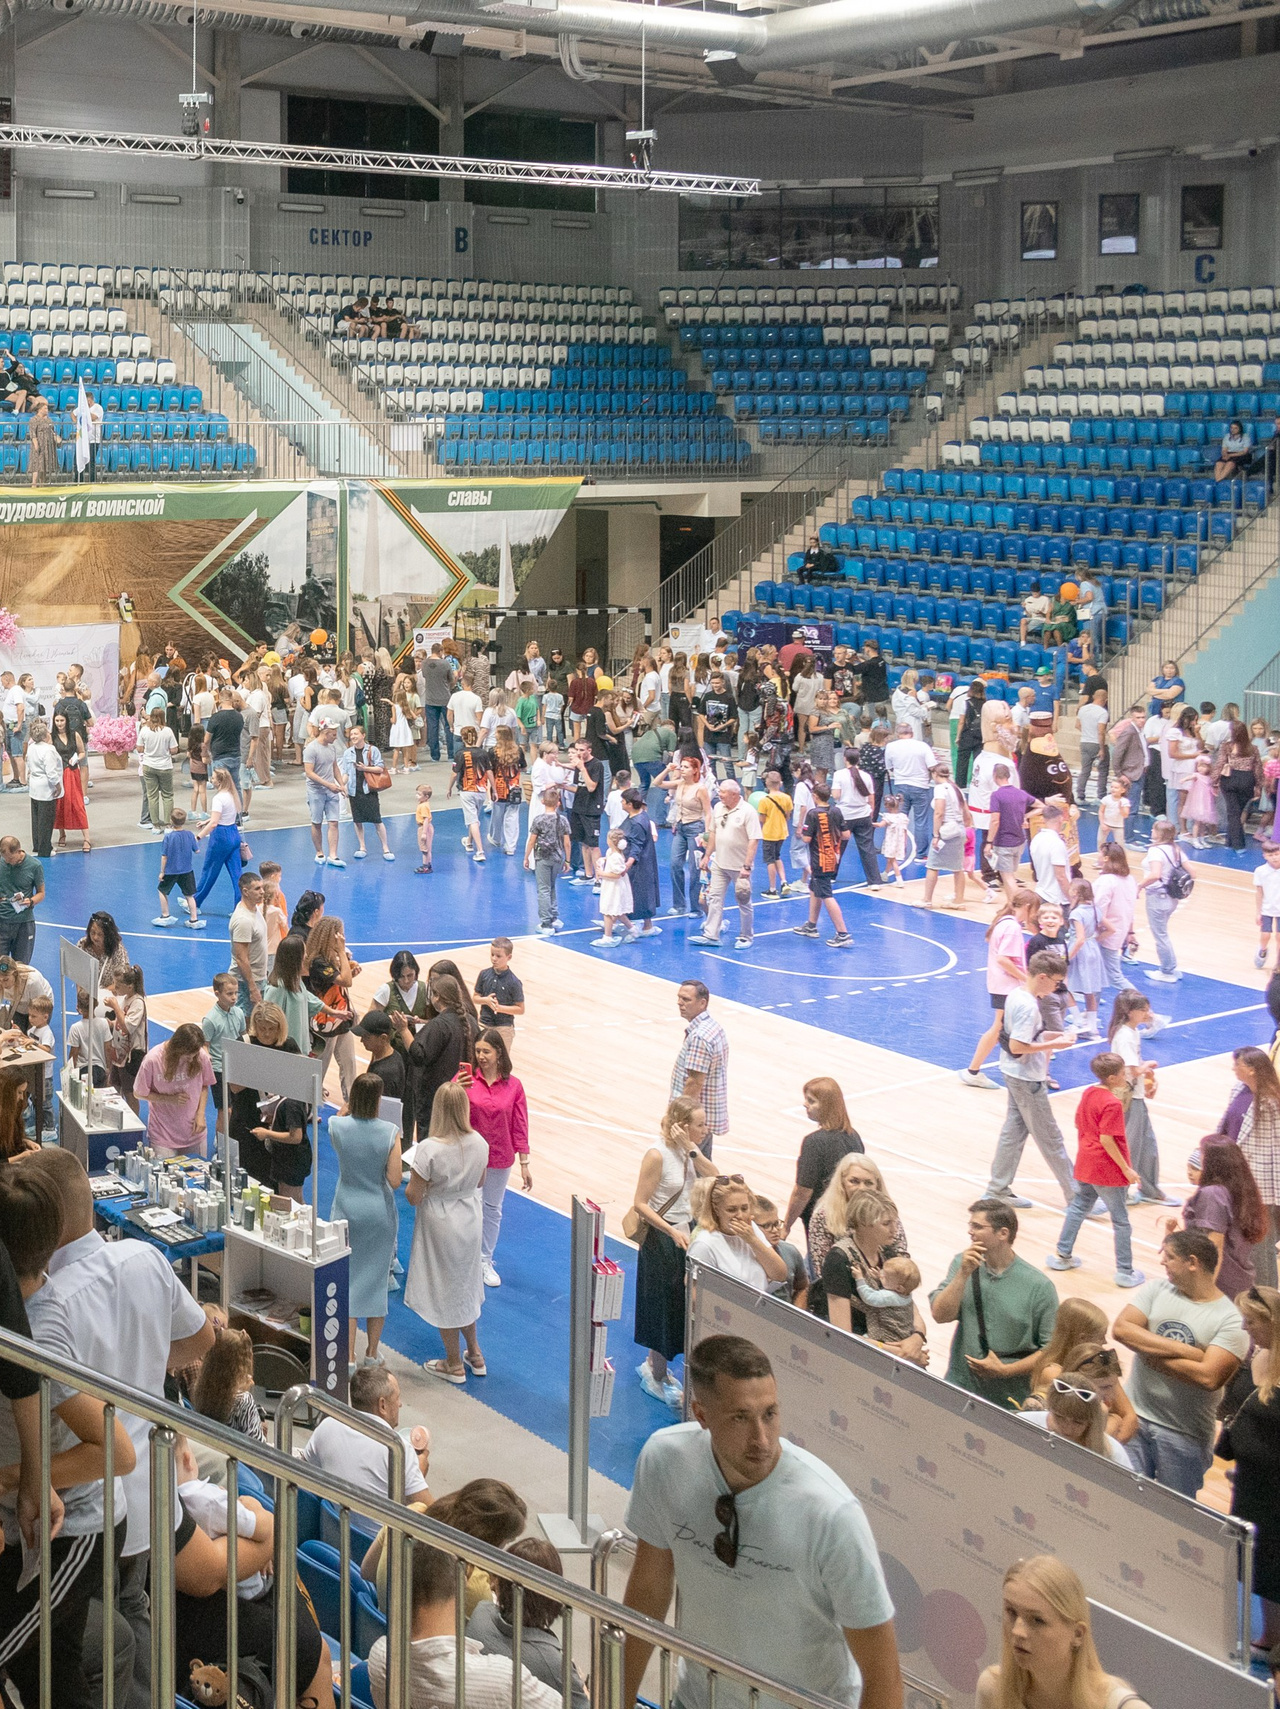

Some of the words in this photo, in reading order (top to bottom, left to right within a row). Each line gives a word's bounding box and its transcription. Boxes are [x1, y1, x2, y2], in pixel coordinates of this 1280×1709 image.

[309, 227, 373, 247] СЕКТОР
[70, 501, 82, 518] и
[86, 494, 165, 518] воинской
[447, 490, 492, 506] славы
